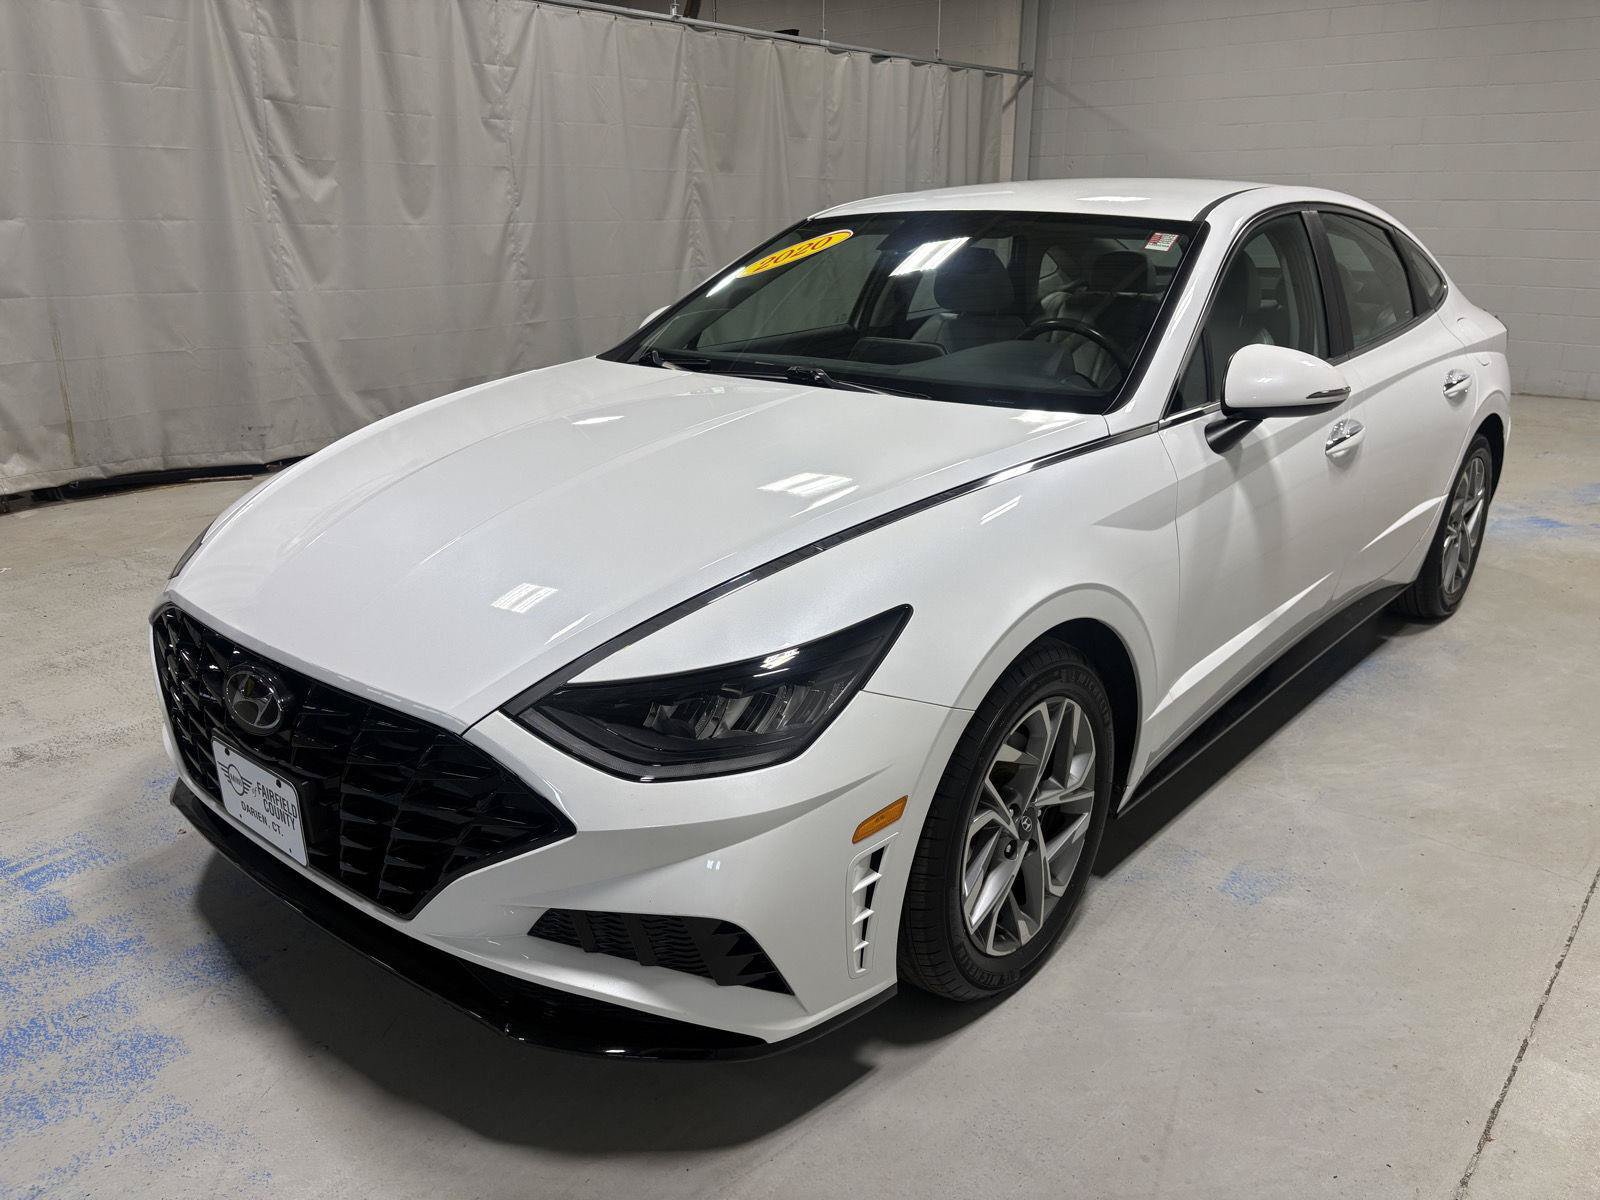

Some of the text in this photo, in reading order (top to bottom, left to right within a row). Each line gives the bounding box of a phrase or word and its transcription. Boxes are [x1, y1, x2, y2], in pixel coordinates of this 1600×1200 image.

[754, 236, 833, 273] 2020
[256, 781, 298, 819] FAIRFIELD
[263, 798, 296, 831] COUNTY
